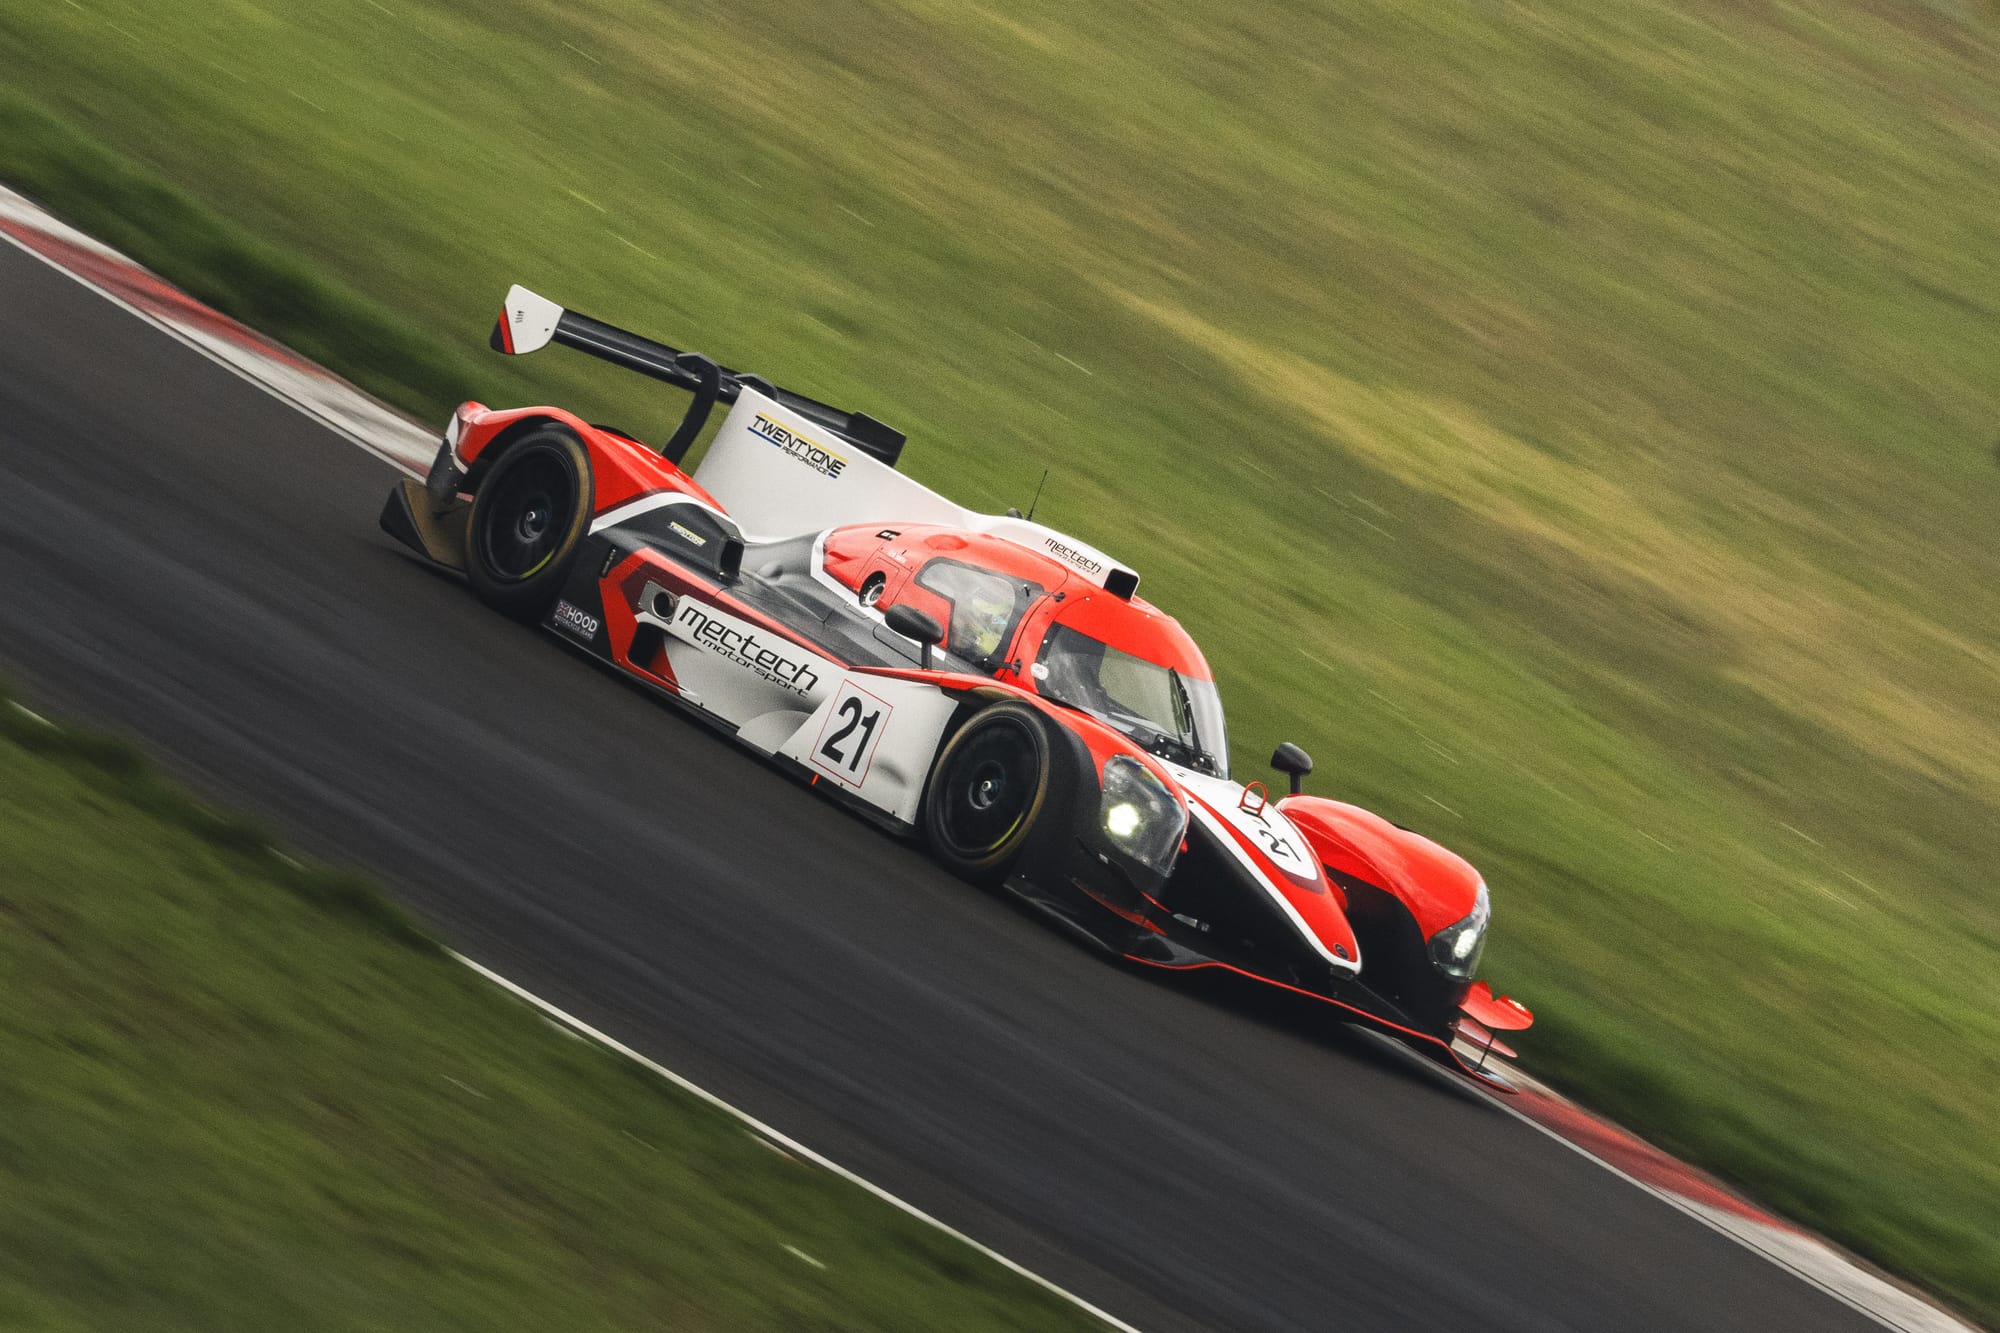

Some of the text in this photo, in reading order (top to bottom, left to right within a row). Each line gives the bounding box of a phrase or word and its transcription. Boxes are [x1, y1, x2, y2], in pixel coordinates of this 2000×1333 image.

[755, 415, 846, 475] TWENTYONE
[782, 446, 828, 475] PERFORMANCE
[1045, 538, 1102, 573] mectech
[566, 607, 597, 632] HOOD
[679, 606, 819, 691] mectech
[703, 639, 808, 698] motorsport
[821, 697, 880, 772] 21
[1259, 829, 1302, 862] 21
